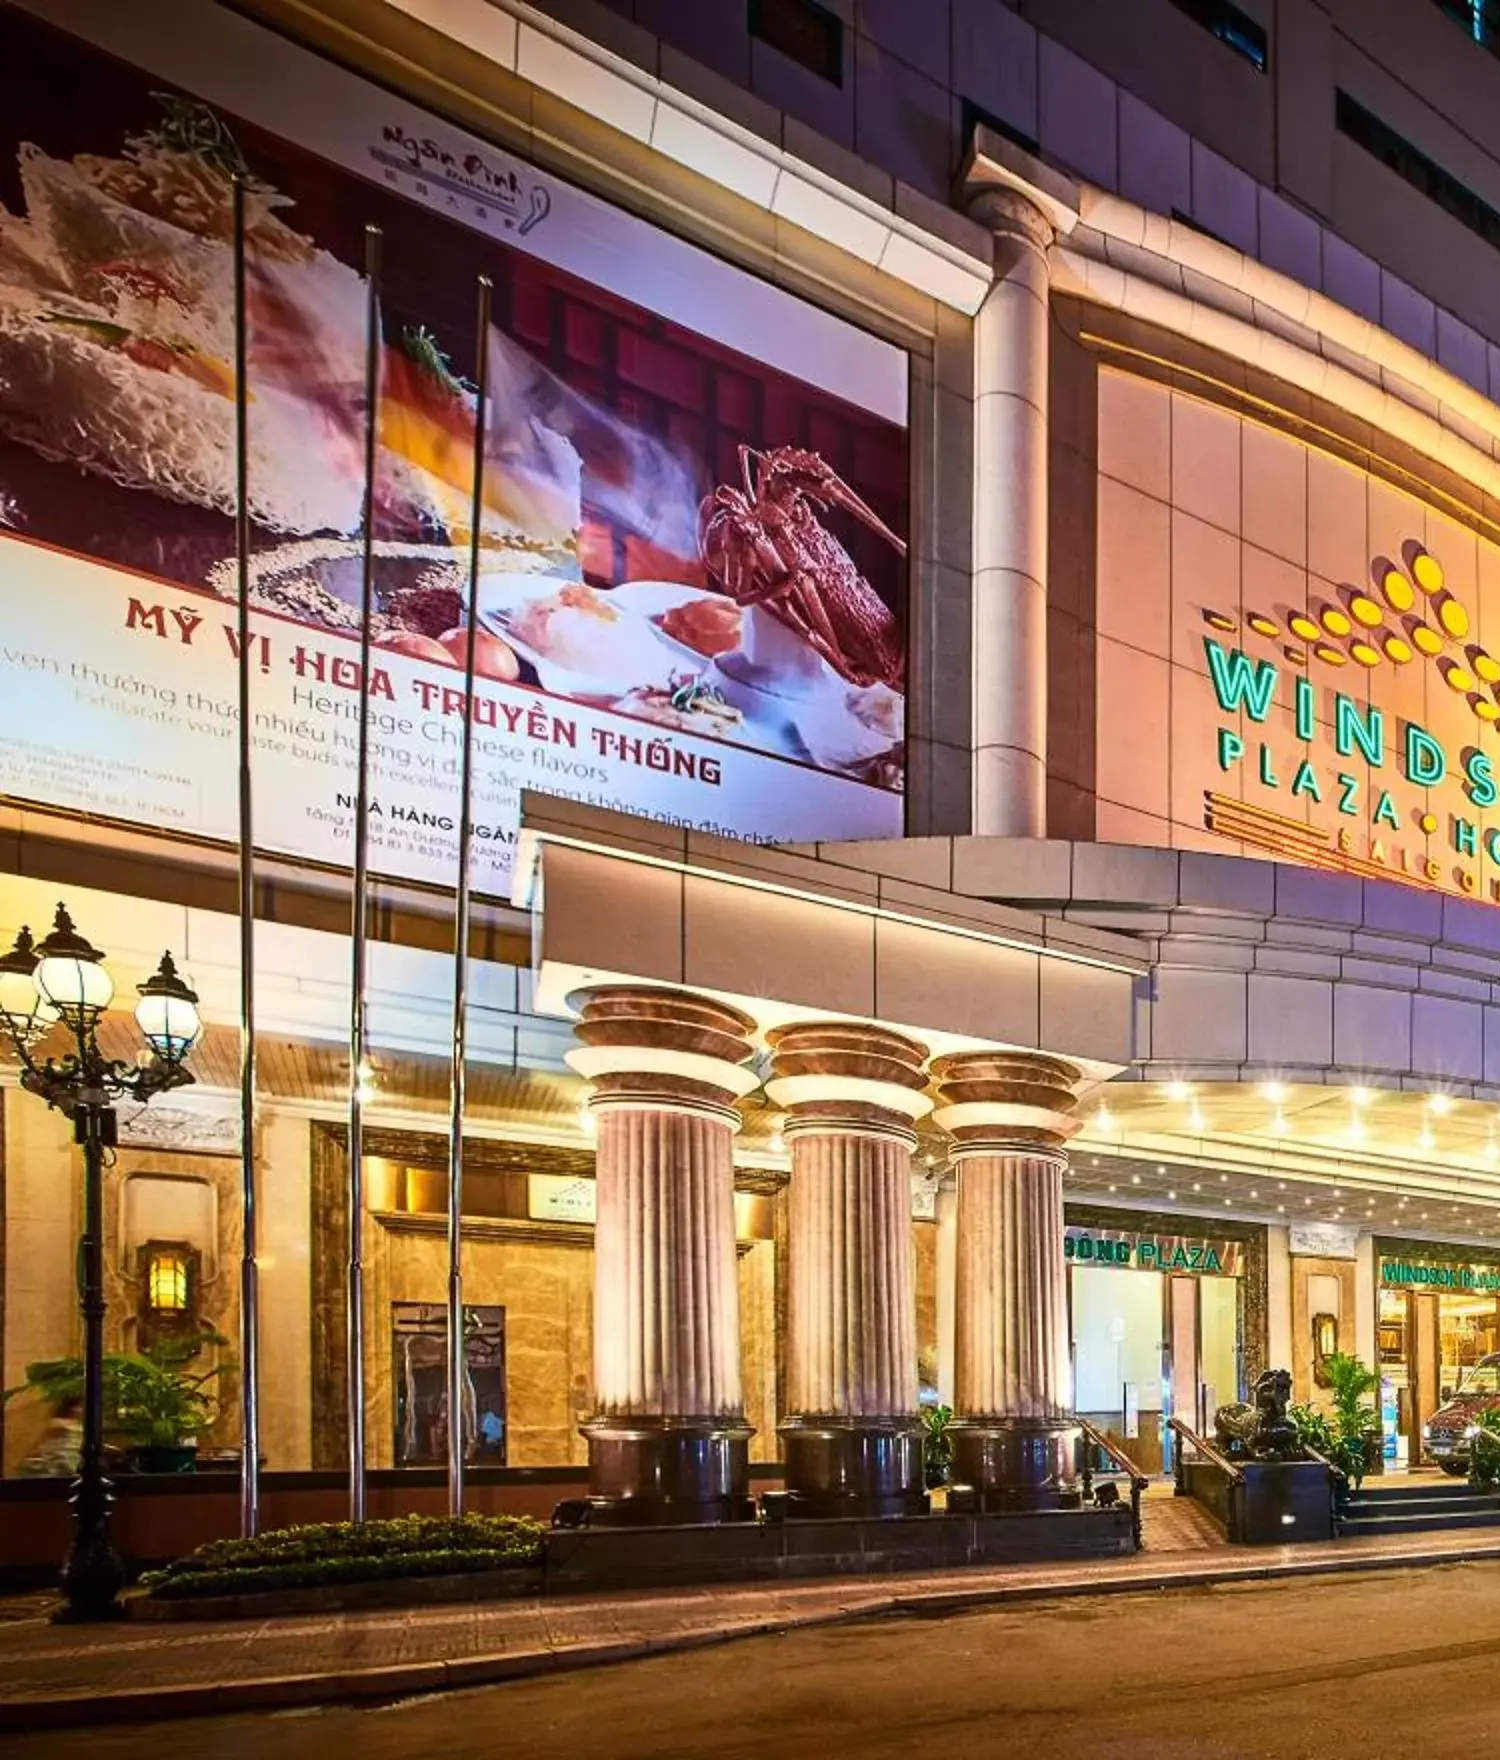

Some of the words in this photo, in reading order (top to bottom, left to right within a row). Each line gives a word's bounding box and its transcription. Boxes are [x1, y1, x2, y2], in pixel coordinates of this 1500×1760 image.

[125, 597, 203, 646] MỸ
[222, 624, 272, 675] VỊ
[289, 645, 397, 702] HOA
[413, 678, 577, 749] TRUYỀN
[591, 727, 720, 786] THỐNG
[292, 685, 413, 736] Heritage
[421, 719, 525, 762] Chinese
[532, 745, 609, 784] flavors
[1217, 727, 1400, 831] PLAZA
[391, 804, 454, 831] HÀNG
[1137, 1241, 1222, 1270] PLAZA
[1382, 1263, 1457, 1288] WINDSOR
